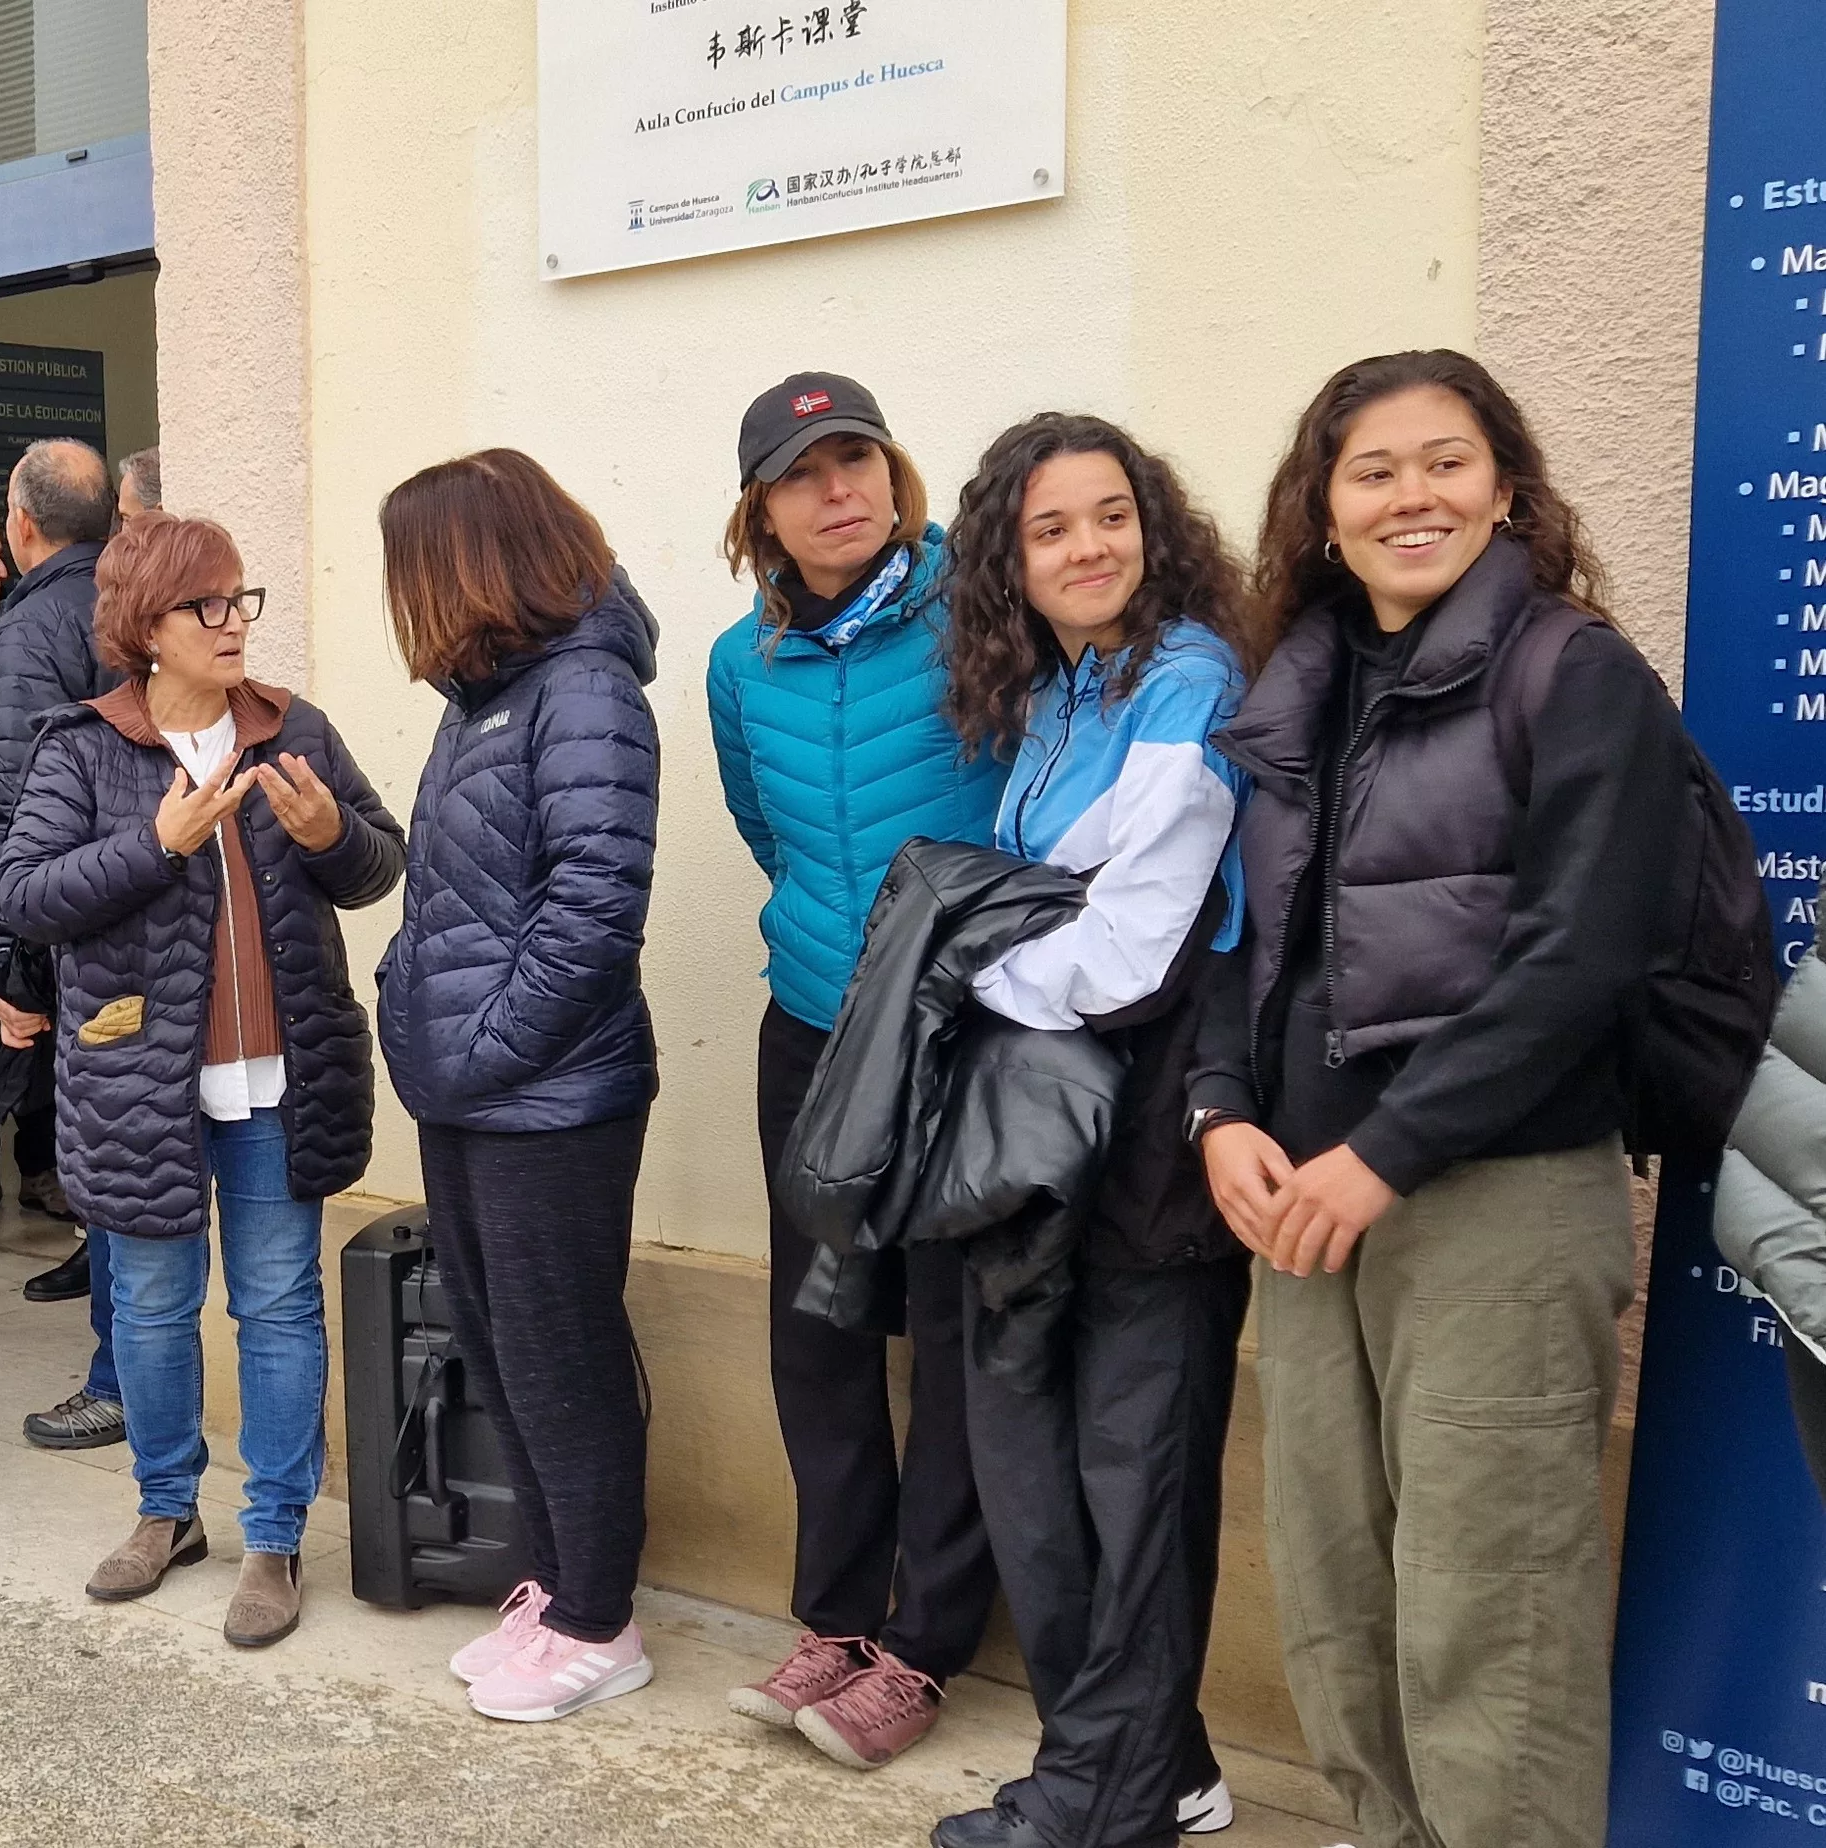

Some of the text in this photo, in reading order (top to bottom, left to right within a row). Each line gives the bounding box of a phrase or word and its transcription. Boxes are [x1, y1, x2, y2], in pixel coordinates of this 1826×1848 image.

[634, 58, 945, 134] Aula Confucio del Campus de Huesca
[865, 181, 900, 194] Institute
[649, 194, 720, 214] Campus de Huesca
[748, 202, 781, 215] Hanban
[649, 204, 734, 226] Universidad Zaragoza
[17, 404, 33, 420] LA
[1751, 1315, 1784, 1349] Fi
[1715, 1779, 1801, 1820] @Fac.
